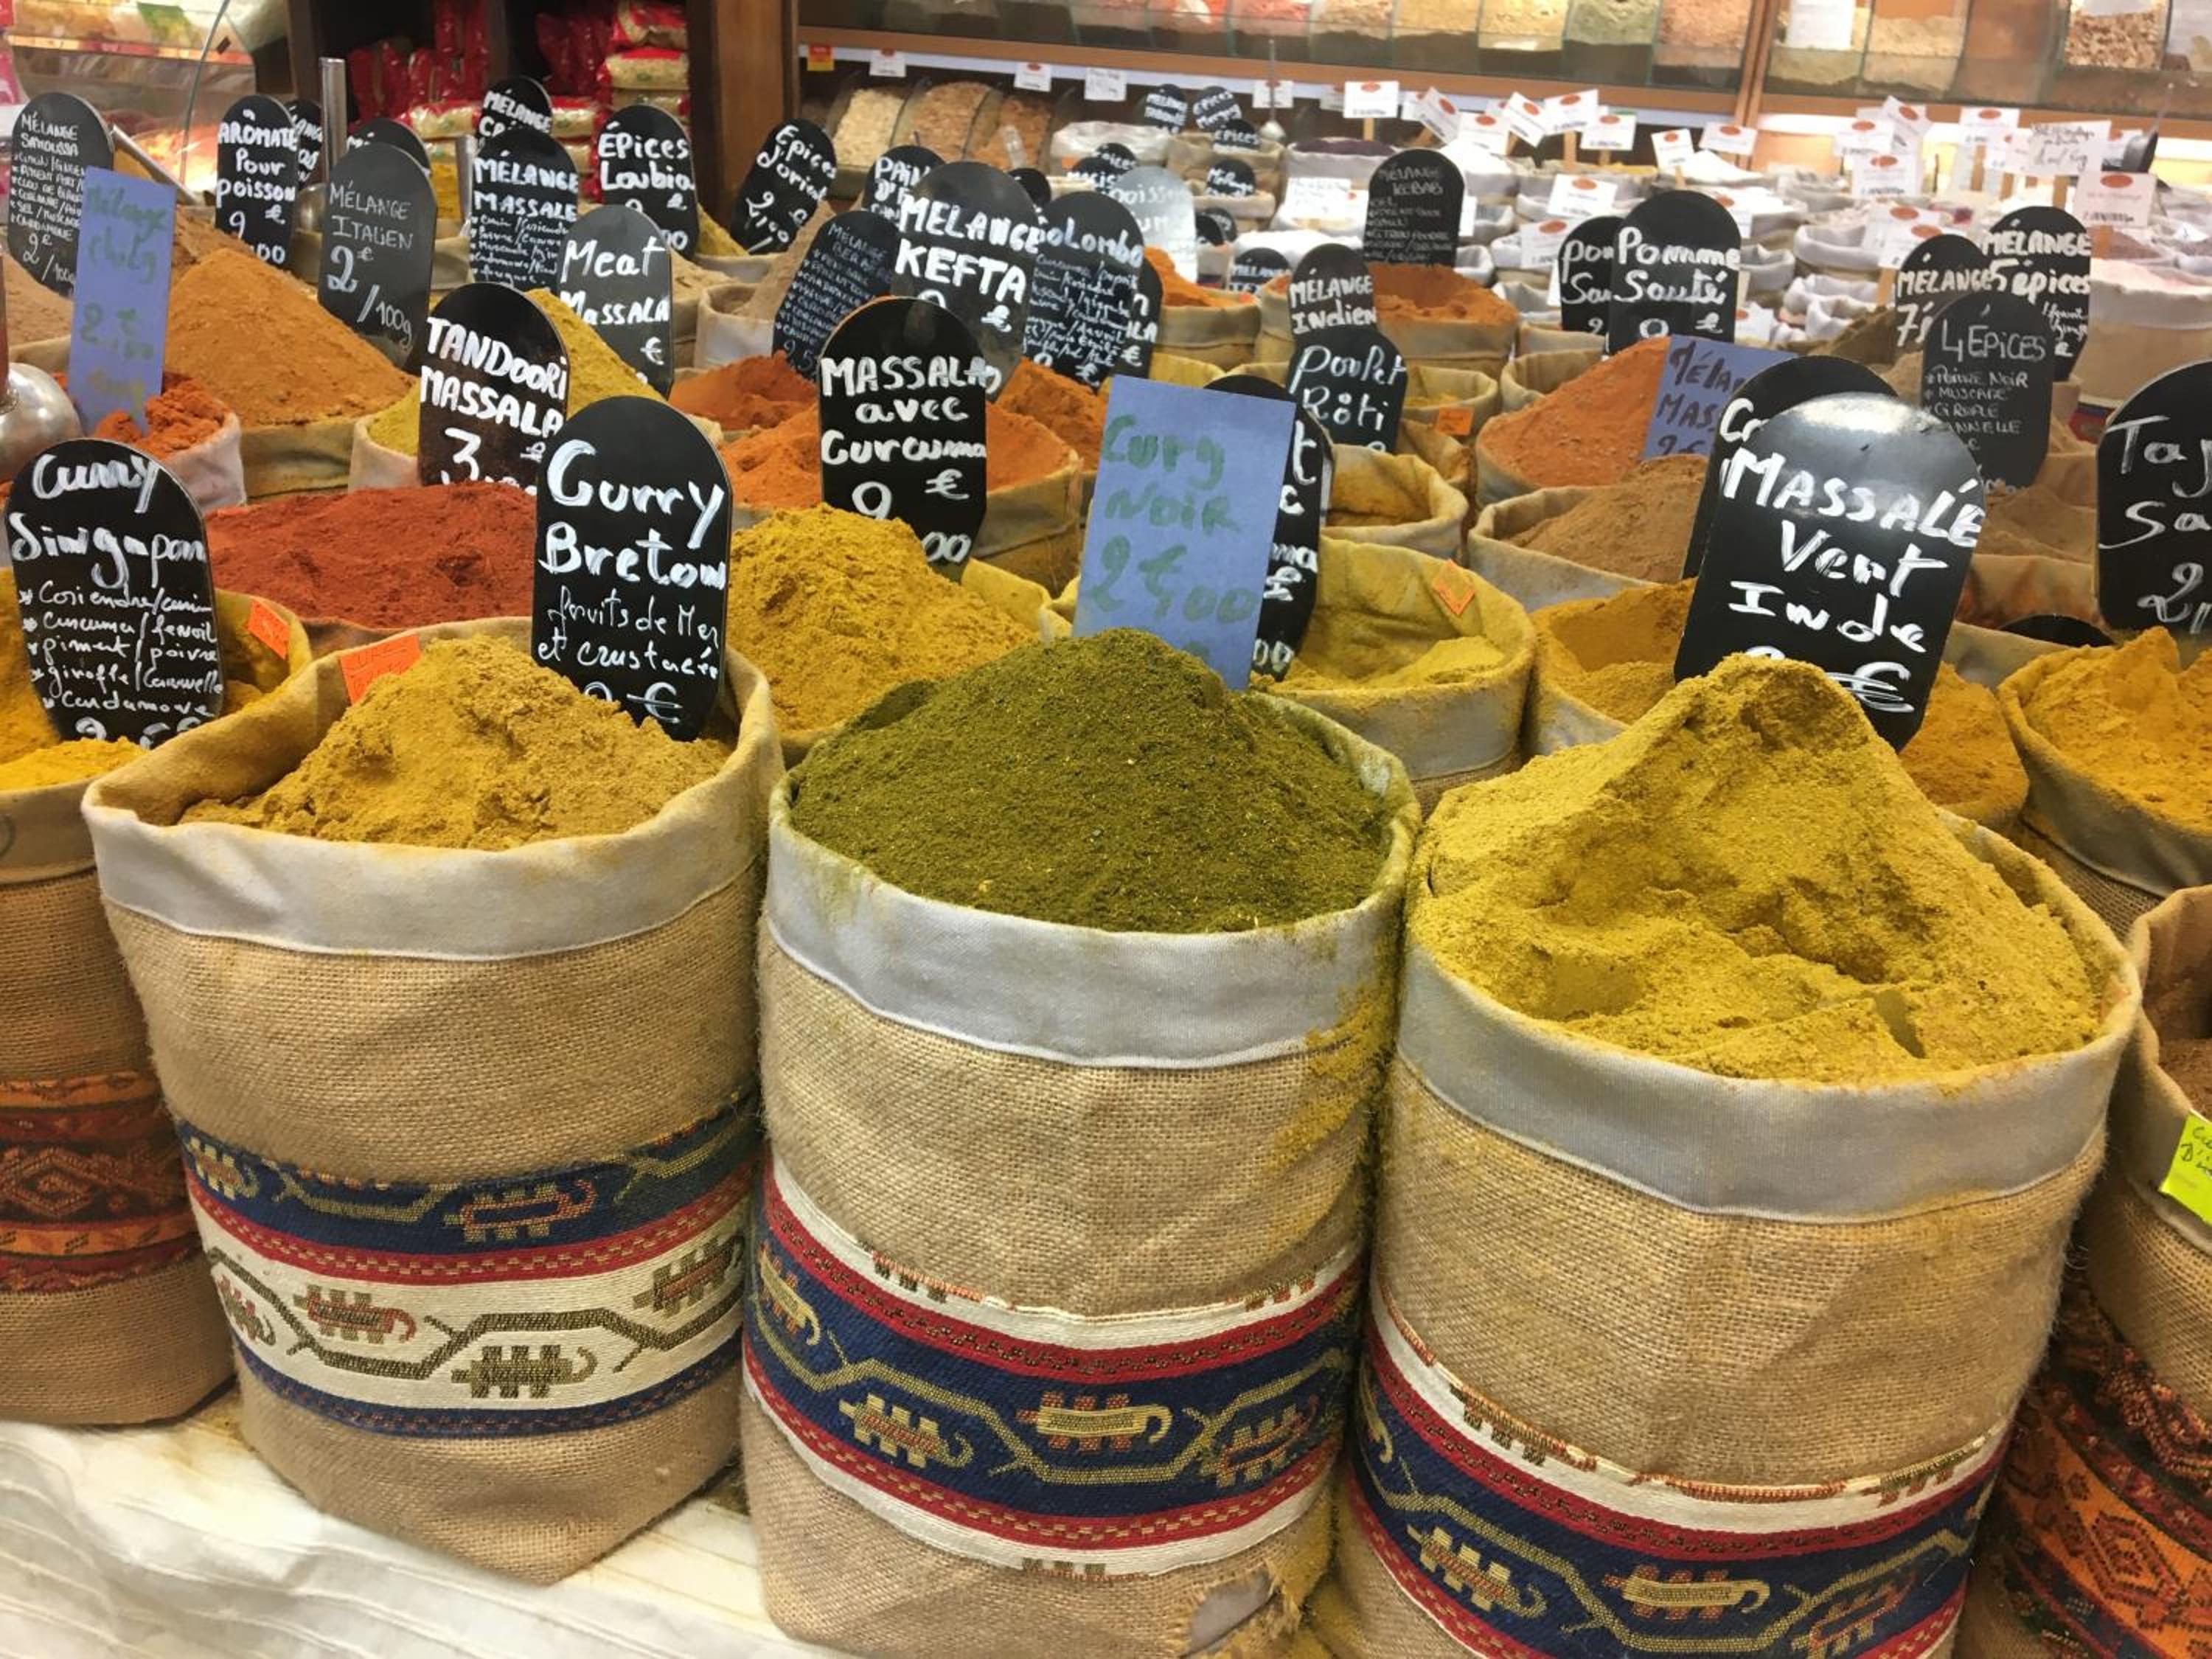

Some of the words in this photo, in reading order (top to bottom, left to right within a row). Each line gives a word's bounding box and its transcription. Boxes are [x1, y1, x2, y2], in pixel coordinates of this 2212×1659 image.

[473, 150, 580, 194] MÉLANGE
[329, 180, 412, 220] MÉLANGE
[1617, 226, 1742, 268] Pomme
[1981, 218, 2093, 257] MÉLANGE
[326, 245, 358, 293] 2
[560, 235, 666, 284] Meat
[894, 238, 1027, 305] KEFTA
[1897, 252, 1992, 297] MÉLANGE
[1290, 268, 1374, 309] MÉLANGE
[639, 336, 664, 365] €
[1941, 318, 1964, 363] 4
[420, 365, 566, 439] MASSALA
[855, 396, 970, 424] avec
[821, 429, 988, 465] Curcuma
[546, 439, 725, 550] Curry
[924, 468, 970, 500] €
[1722, 447, 1988, 548] MASSALÉ
[635, 595, 667, 634] de
[538, 626, 567, 663] et
